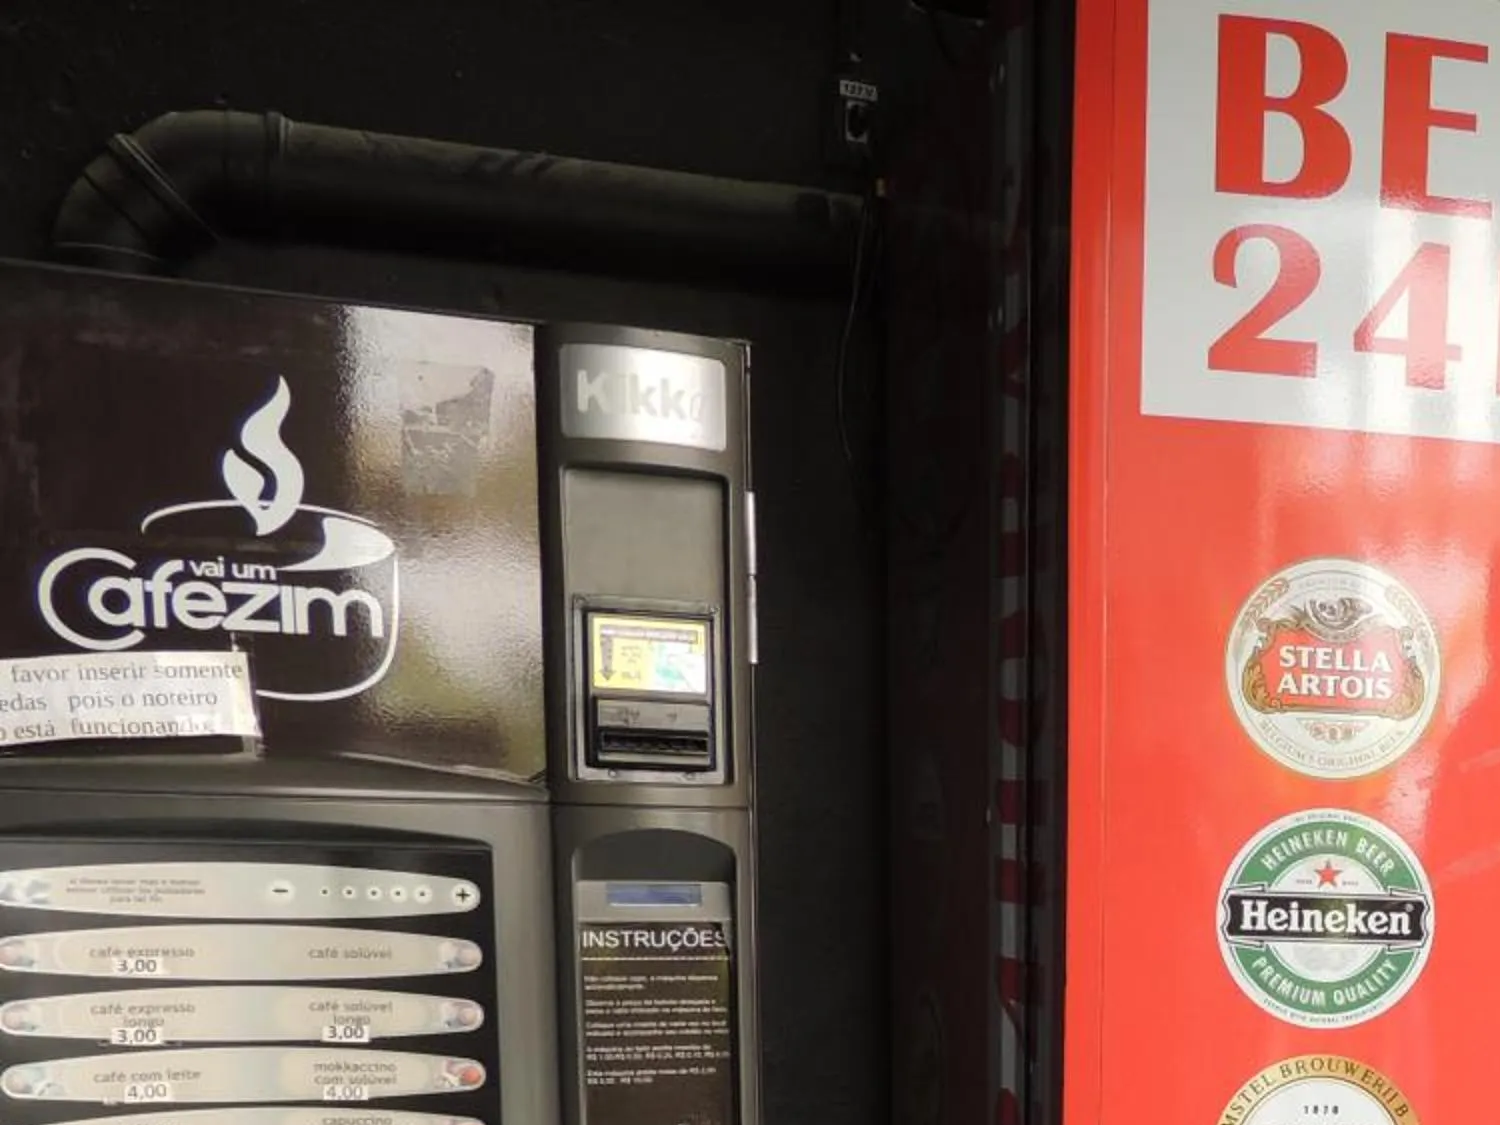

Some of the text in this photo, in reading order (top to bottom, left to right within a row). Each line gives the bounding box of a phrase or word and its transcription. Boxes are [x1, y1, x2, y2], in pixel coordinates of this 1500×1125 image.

[189, 555, 277, 581] vai um
[38, 547, 384, 650] Cafezim
[1279, 645, 1392, 673] STELLA
[11, 664, 70, 683] favor
[79, 661, 147, 681] inserir
[1277, 673, 1392, 699] ARTOIS
[69, 692, 115, 712] pois
[14, 720, 56, 738] está
[1260, 829, 1396, 877] HEINEKEN BEER
[1240, 900, 1412, 935] Heineken
[582, 927, 725, 952] INSTRUÇÕES
[90, 946, 122, 958] café
[308, 947, 339, 959] café
[118, 960, 157, 974] 3,00
[1251, 956, 1398, 1007] PREMIUM QUALITY
[90, 1003, 123, 1015] café
[308, 1000, 339, 1012] café
[118, 1029, 157, 1044] 3,00
[93, 1068, 202, 1084] café com leite
[127, 1084, 168, 1101] 4,00
